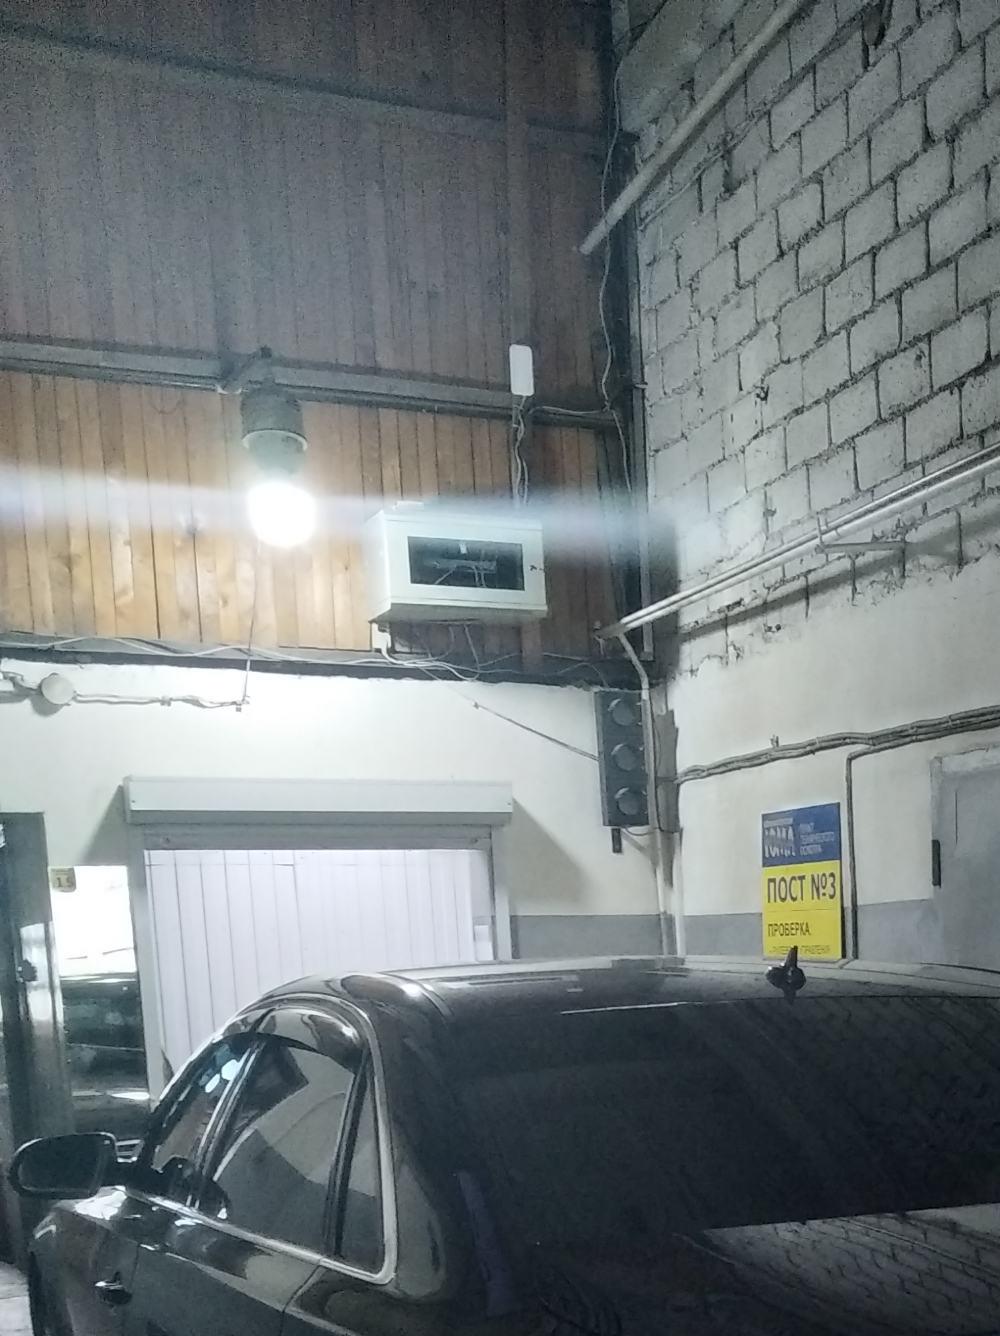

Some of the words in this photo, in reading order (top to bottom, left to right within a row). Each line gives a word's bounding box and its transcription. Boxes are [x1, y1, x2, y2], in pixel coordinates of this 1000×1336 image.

[767, 874, 806, 903] ПОСТ
[811, 871, 836, 901] №3
[767, 921, 811, 937] ПРОВЕРКА
